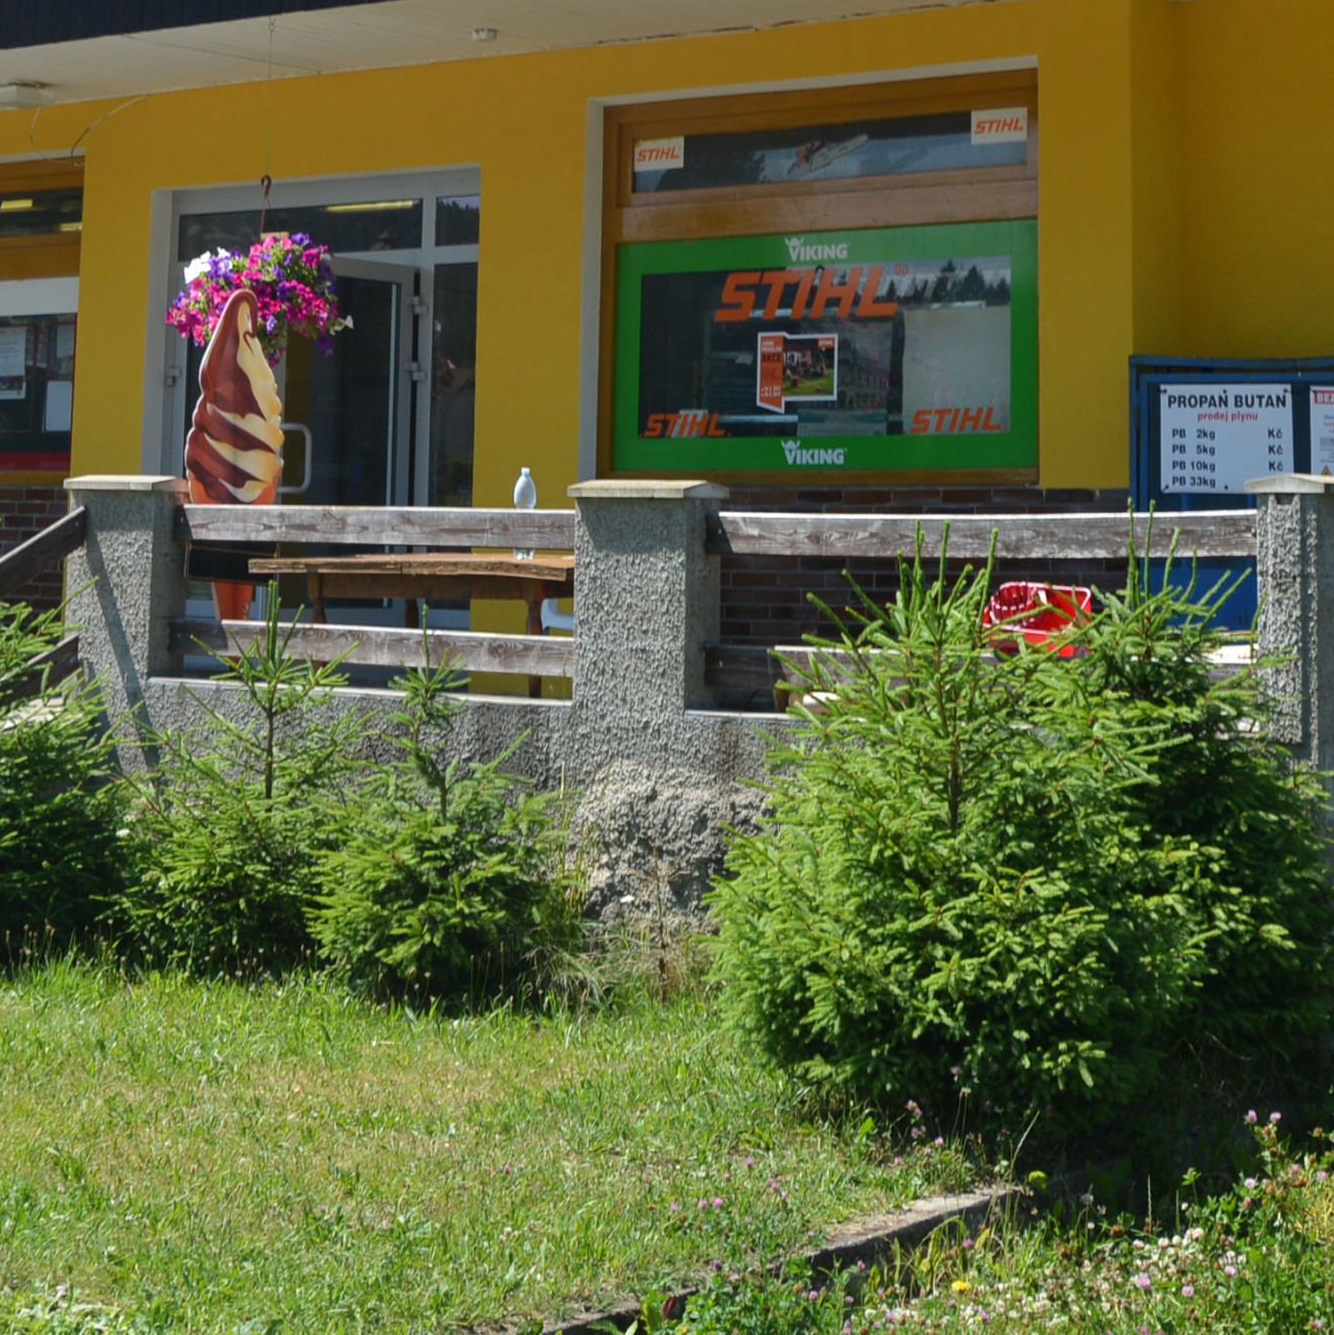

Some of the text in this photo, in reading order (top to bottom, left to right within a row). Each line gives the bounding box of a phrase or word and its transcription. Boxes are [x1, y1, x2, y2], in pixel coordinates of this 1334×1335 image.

[973, 117, 1024, 135] STIHL
[636, 145, 680, 163] STIHL
[788, 244, 849, 262] VIKING
[713, 265, 899, 323] STIHL
[1167, 394, 1287, 409] PROPAN BUTAN
[644, 413, 726, 437] STIHL
[909, 407, 1002, 434] STIHL
[1197, 411, 1259, 423] prodej plynu
[1172, 428, 1284, 441] PB 2kg Kč
[784, 446, 845, 466] VIKING
[1172, 444, 1284, 457] PB 5kg Kč
[1172, 460, 1284, 473] PB 10kg Kč
[1172, 476, 1216, 489] PB 33kg
